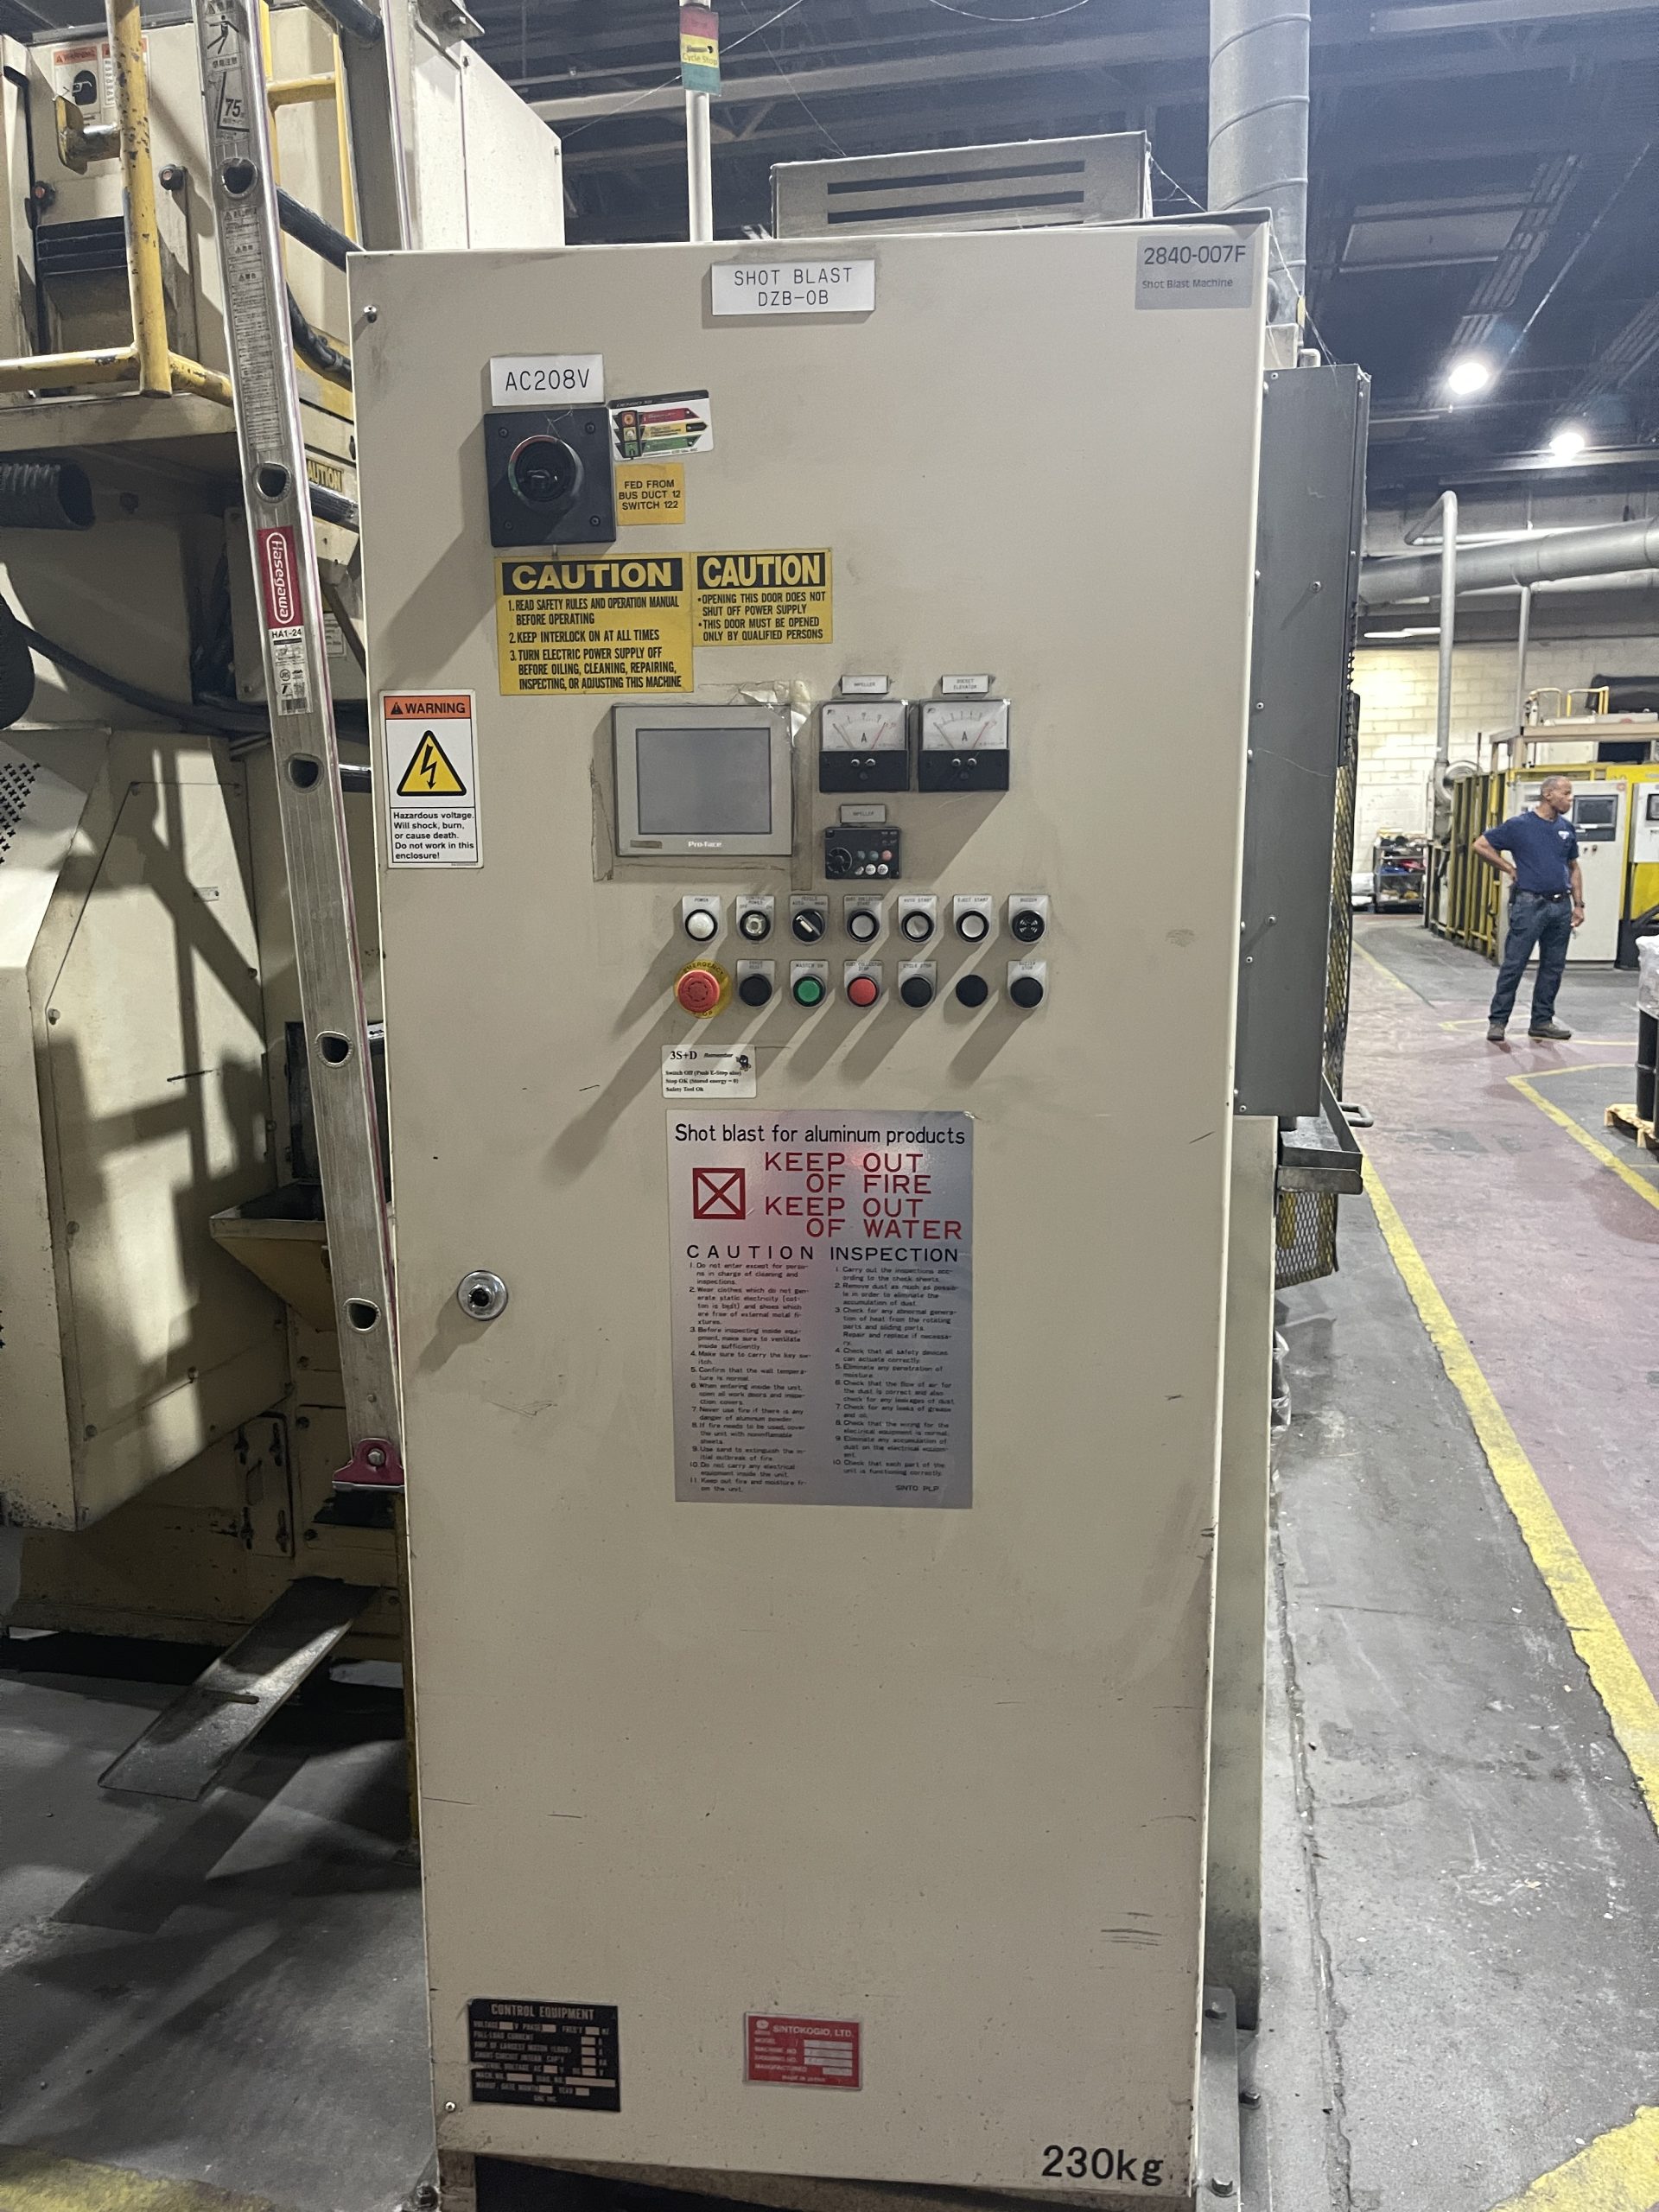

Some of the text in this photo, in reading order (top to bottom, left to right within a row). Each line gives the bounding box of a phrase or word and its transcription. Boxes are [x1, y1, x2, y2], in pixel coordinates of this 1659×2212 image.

[703, 56, 717, 66] Stop
[1144, 245, 1246, 264] 2840-007F
[734, 267, 853, 286] SHOT BLAST
[1142, 278, 1233, 289] Shot Blast Machine
[505, 368, 589, 391] AC208V
[307, 461, 342, 492] AUTION
[646, 480, 674, 488] FROM
[622, 501, 659, 510] SWITCH
[271, 540, 289, 618] Hasegawa
[512, 562, 672, 590] CAUTION
[702, 555, 820, 588] CAUTION
[508, 596, 679, 611] 1. READ SAFETY RULES AND OPERATION MANUAL
[741, 594, 758, 603] THIS
[761, 593, 783, 602] DOOR
[786, 592, 806, 602] DOES
[810, 591, 826, 601] NOT
[702, 604, 807, 617] SHUT OFF POWER SUPPLY
[517, 613, 594, 626] BEFORE OPERATING
[703, 617, 819, 629] THIS DOOR MUST BE OPENED
[272, 629, 302, 639] HA1-24
[517, 632, 537, 643] KEEP
[541, 631, 586, 643] INTERLOCK
[588, 631, 601, 642] ON
[604, 630, 613, 641] AT
[616, 630, 632, 641] ALL
[633, 629, 659, 641] TIMES
[703, 629, 823, 642] ONLY BY QUALIFIED PERSONS
[518, 649, 539, 661] TURN
[543, 648, 581, 660] ELECTRIC
[583, 647, 612, 660] POWER
[614, 647, 645, 659] SUPPLY
[648, 646, 662, 658] OFF
[518, 661, 677, 676] BEFORE OILING, CLEANING, REPAIRING,
[519, 676, 682, 691] INSPECTING, OR ADJUSTING THIS MACHINE
[405, 702, 466, 715] WARNING
[670, 1051, 697, 1059] 3S+D
[675, 1123, 965, 1147] Shot blast for aluminum products
[766, 1151, 924, 1173] KEEP OUT
[806, 1173, 932, 1195] OF FIRE
[766, 1196, 924, 1218] KEEP OUT
[806, 1217, 963, 1241] OF WATER
[686, 1245, 813, 1260] CAUTION
[830, 1247, 957, 1262] INSPECTION
[491, 2004, 594, 2020] CONTROL EQUIPMENT
[772, 2025, 854, 2037] SINTOKOGIO, LTD.
[1041, 2145, 1164, 2186] 230kg
